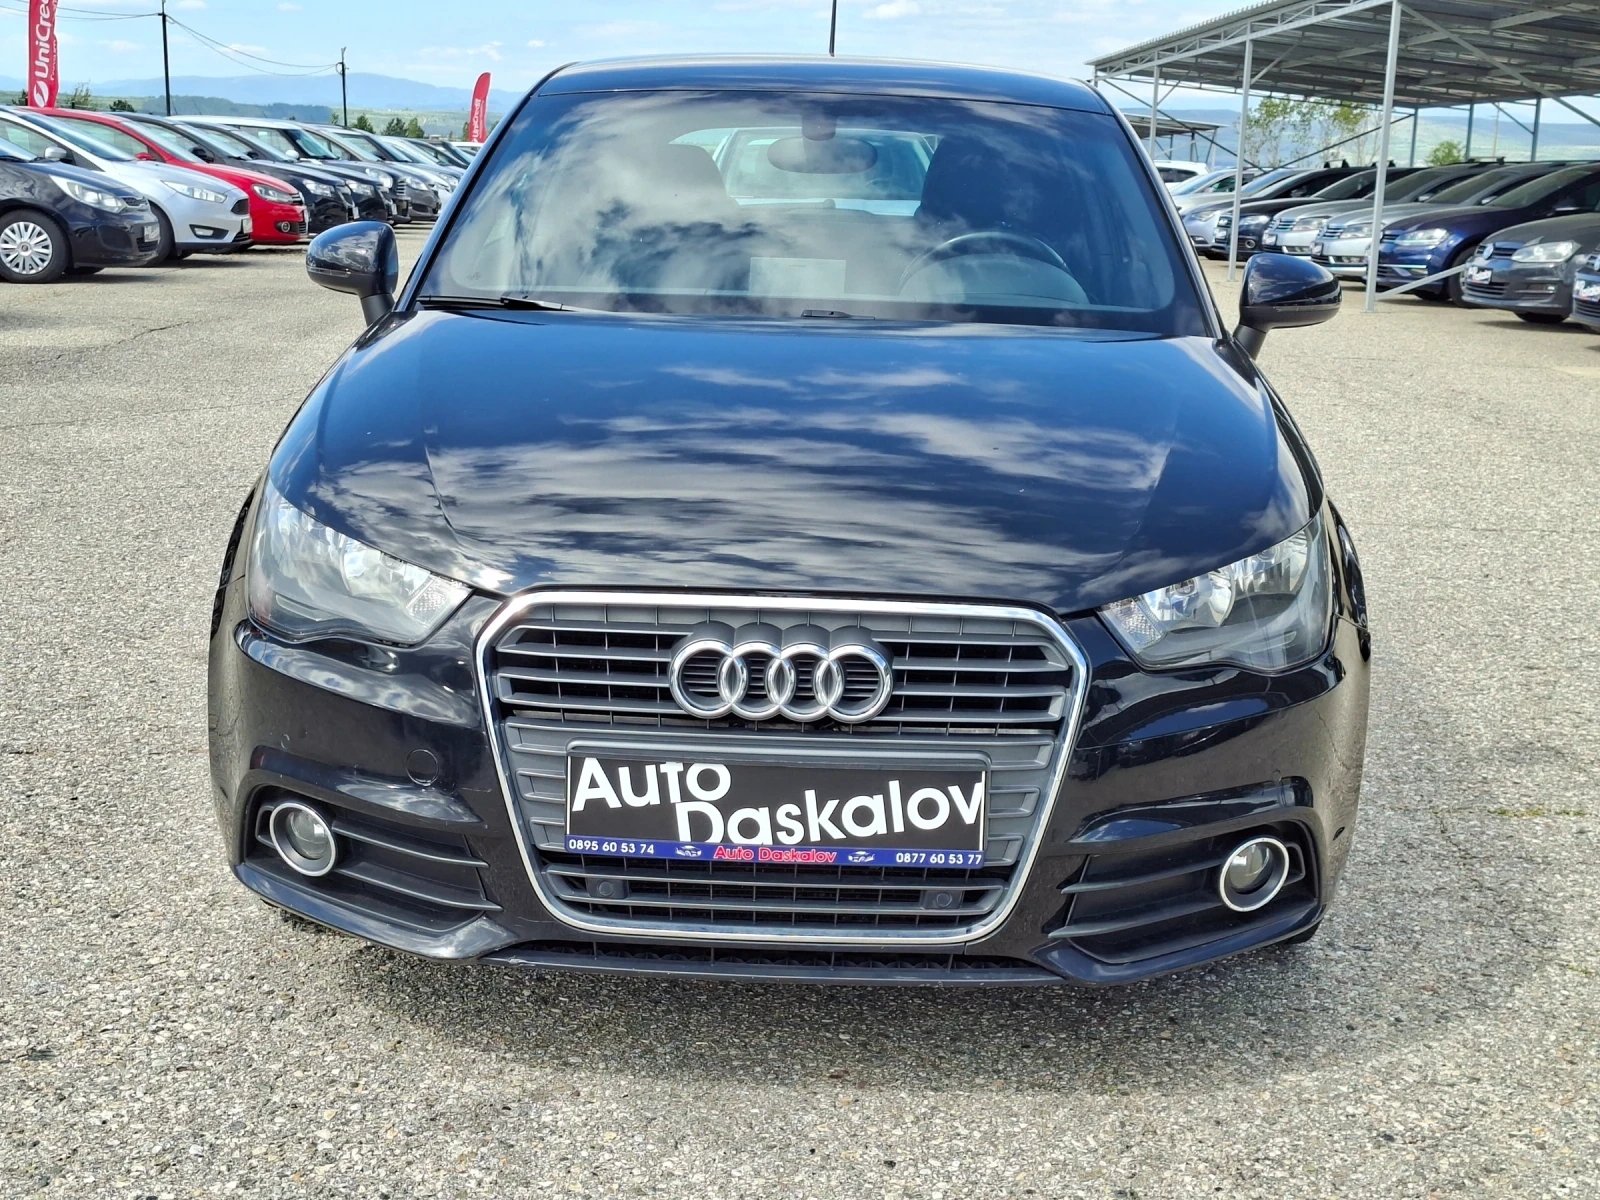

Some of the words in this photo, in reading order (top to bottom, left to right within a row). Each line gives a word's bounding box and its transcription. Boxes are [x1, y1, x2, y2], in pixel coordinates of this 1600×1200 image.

[572, 757, 731, 812] Auto
[675, 779, 983, 846] Daskalov
[568, 839, 599, 851] 0895
[602, 841, 617, 852] 60
[621, 842, 636, 854] 53
[640, 843, 655, 855] 74
[713, 846, 755, 861] Auto
[758, 847, 837, 863] Daskalov
[895, 852, 926, 864] 0877
[929, 853, 945, 864] 60
[948, 853, 964, 865] 53
[967, 854, 982, 865] 77
